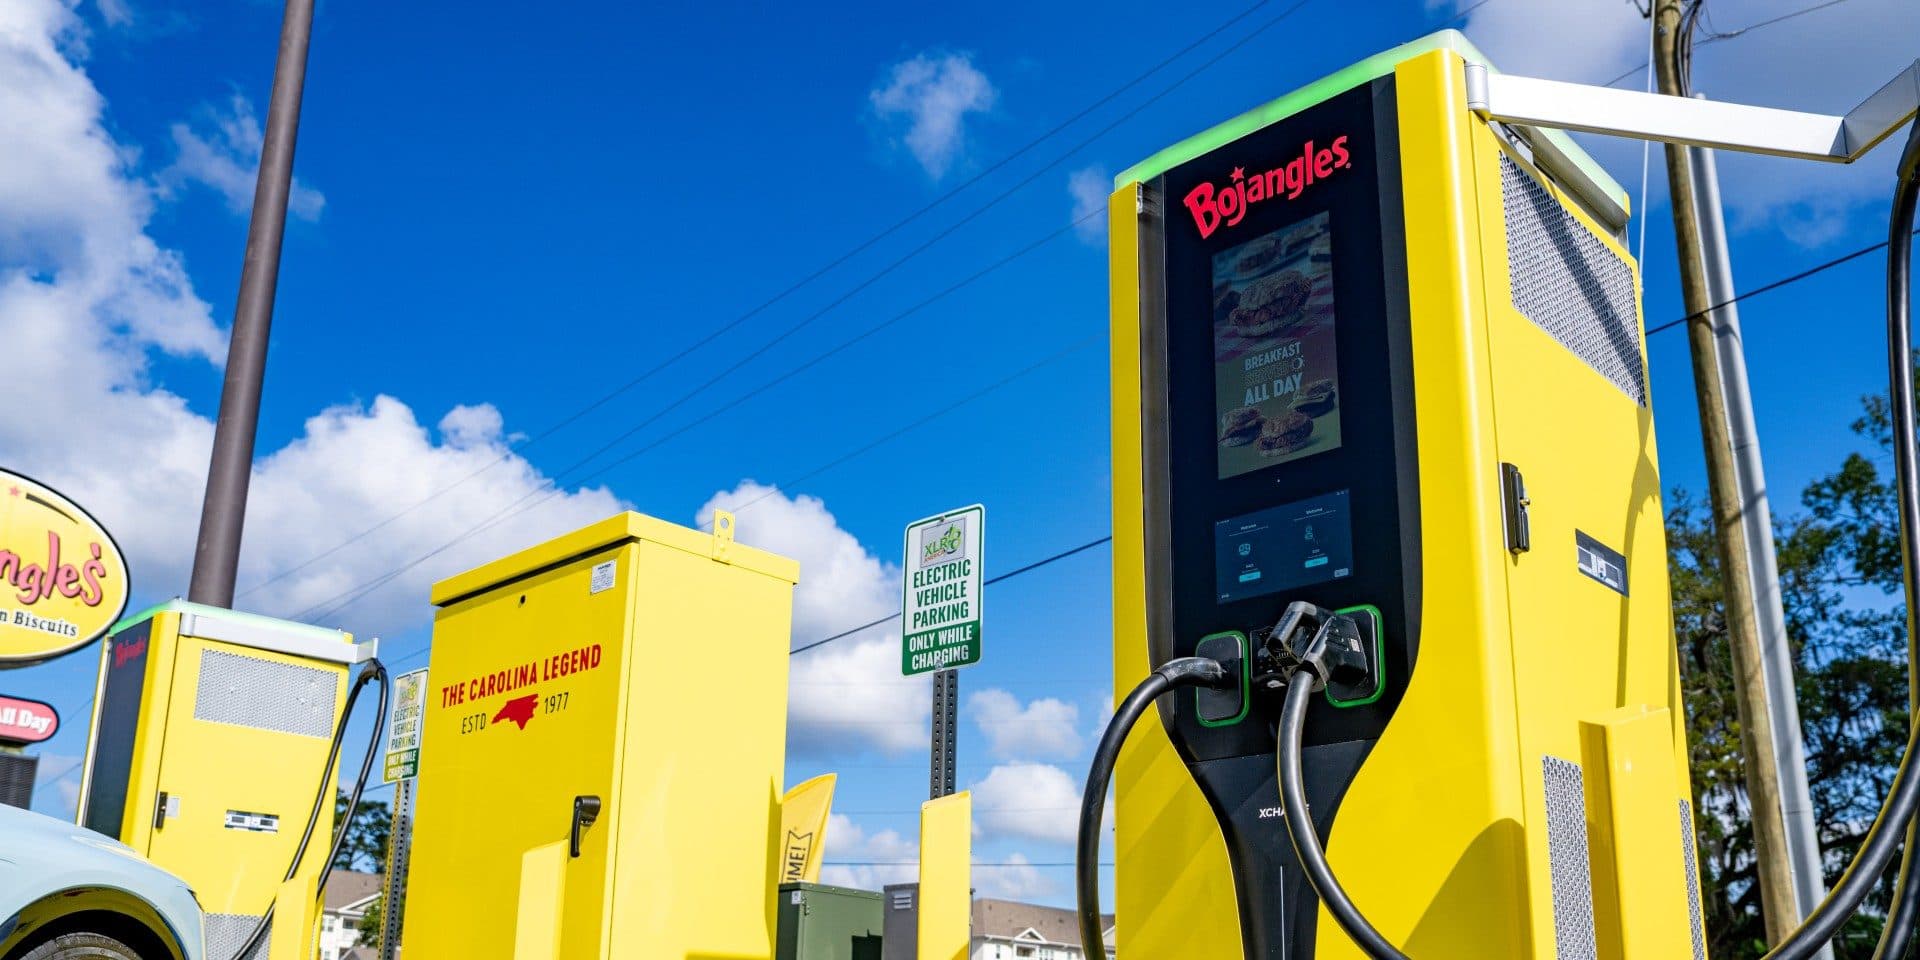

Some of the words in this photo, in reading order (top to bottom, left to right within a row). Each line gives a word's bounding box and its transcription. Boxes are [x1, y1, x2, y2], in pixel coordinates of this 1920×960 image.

[1183, 135, 1349, 239] Bojangles
[1244, 342, 1301, 371] BREAKFAST
[1244, 384, 1269, 407] ALL
[1273, 372, 1302, 397] DAY
[913, 558, 971, 589] ELECTRIC
[916, 580, 967, 608] VEHICLE
[14, 611, 77, 637] Biscuits
[913, 601, 969, 629] PARKING
[909, 633, 935, 652] ONLY
[938, 625, 972, 646] WHILE
[911, 644, 969, 671] CHARGING
[442, 682, 466, 708] THE
[469, 662, 537, 701] CAROLINA
[543, 644, 602, 681] LEGEND
[18, 709, 52, 734] Day
[394, 705, 420, 722] ELECTRIC
[461, 712, 487, 735] ESTD
[544, 692, 569, 714] 1977
